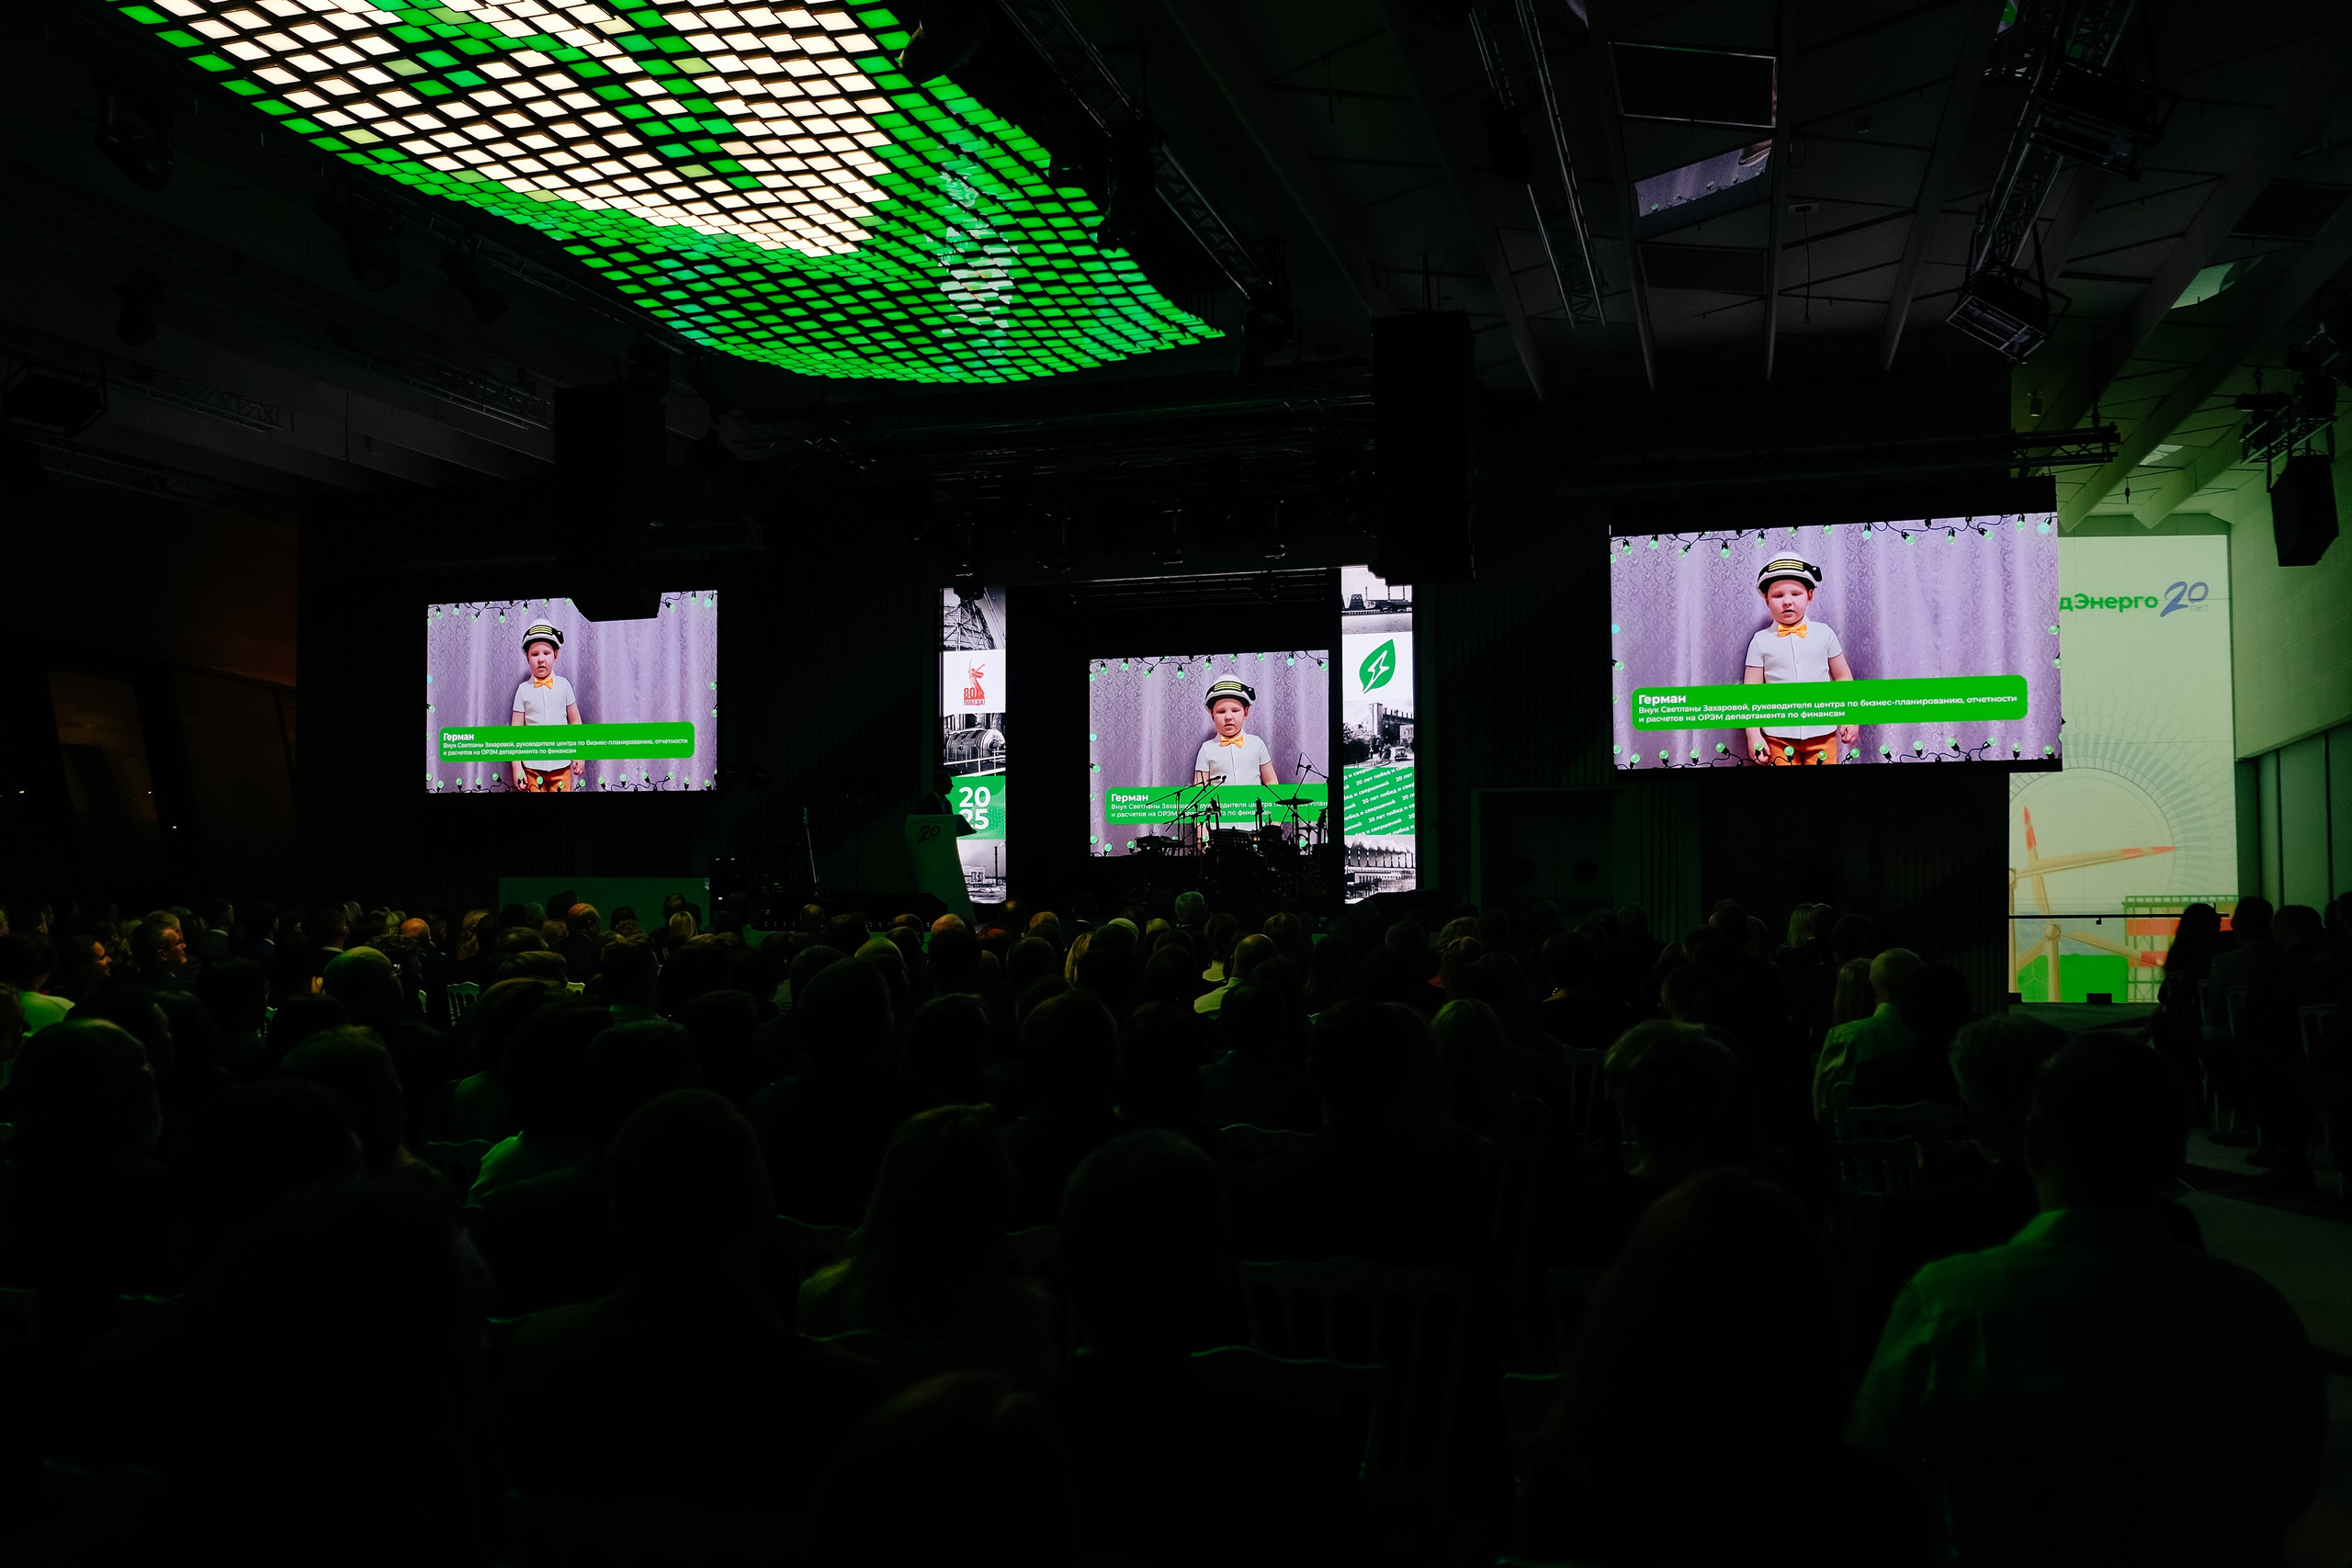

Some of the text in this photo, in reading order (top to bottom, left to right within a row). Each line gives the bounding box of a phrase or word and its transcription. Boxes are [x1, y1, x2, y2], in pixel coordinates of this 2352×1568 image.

[2160, 581, 2209, 617] 20
[1638, 694, 1686, 706] Герман
[1703, 704, 1749, 712] Захаровой,
[1752, 703, 1811, 711] руководителя
[1860, 698, 1964, 706] бизнес-планированию,
[443, 733, 474, 743] Герман
[959, 786, 991, 807] 20
[1111, 794, 1148, 804] Герман
